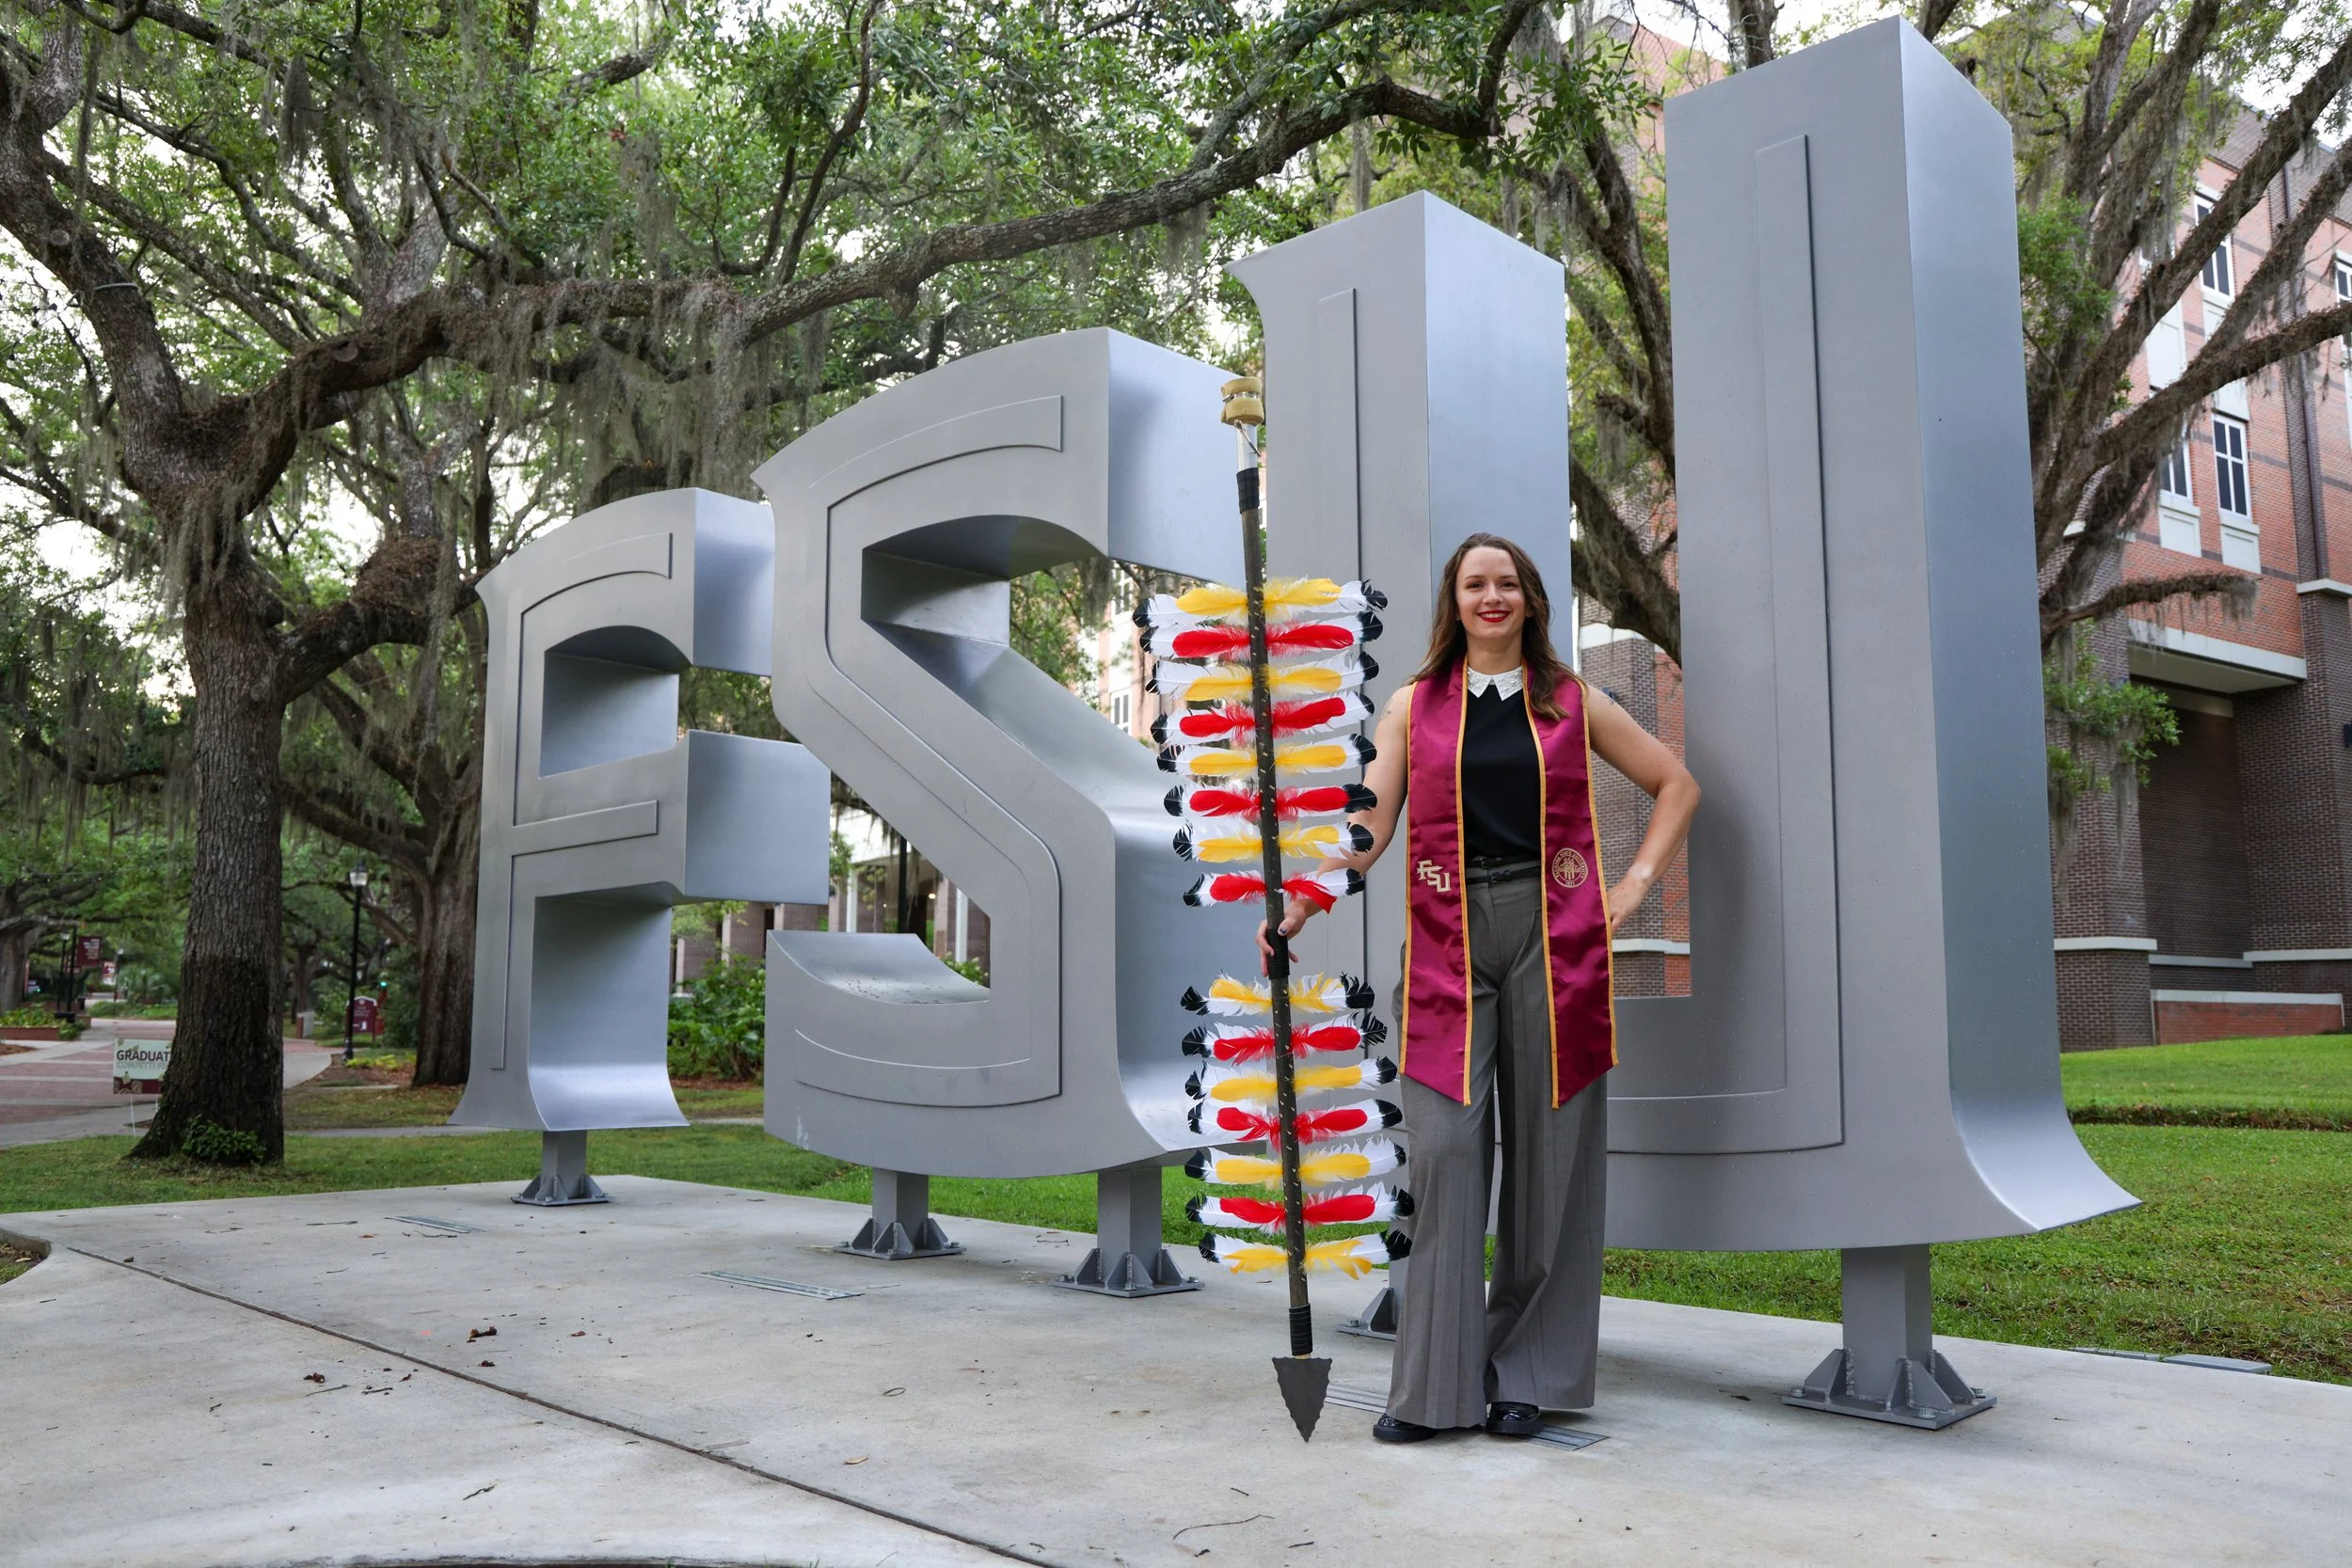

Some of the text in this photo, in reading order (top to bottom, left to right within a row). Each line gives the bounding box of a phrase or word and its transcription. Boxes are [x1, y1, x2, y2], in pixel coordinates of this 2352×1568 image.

[450, 18, 2138, 1252] FSU
[1416, 860, 1452, 893] FSU
[117, 1050, 170, 1062] GRADUAT
